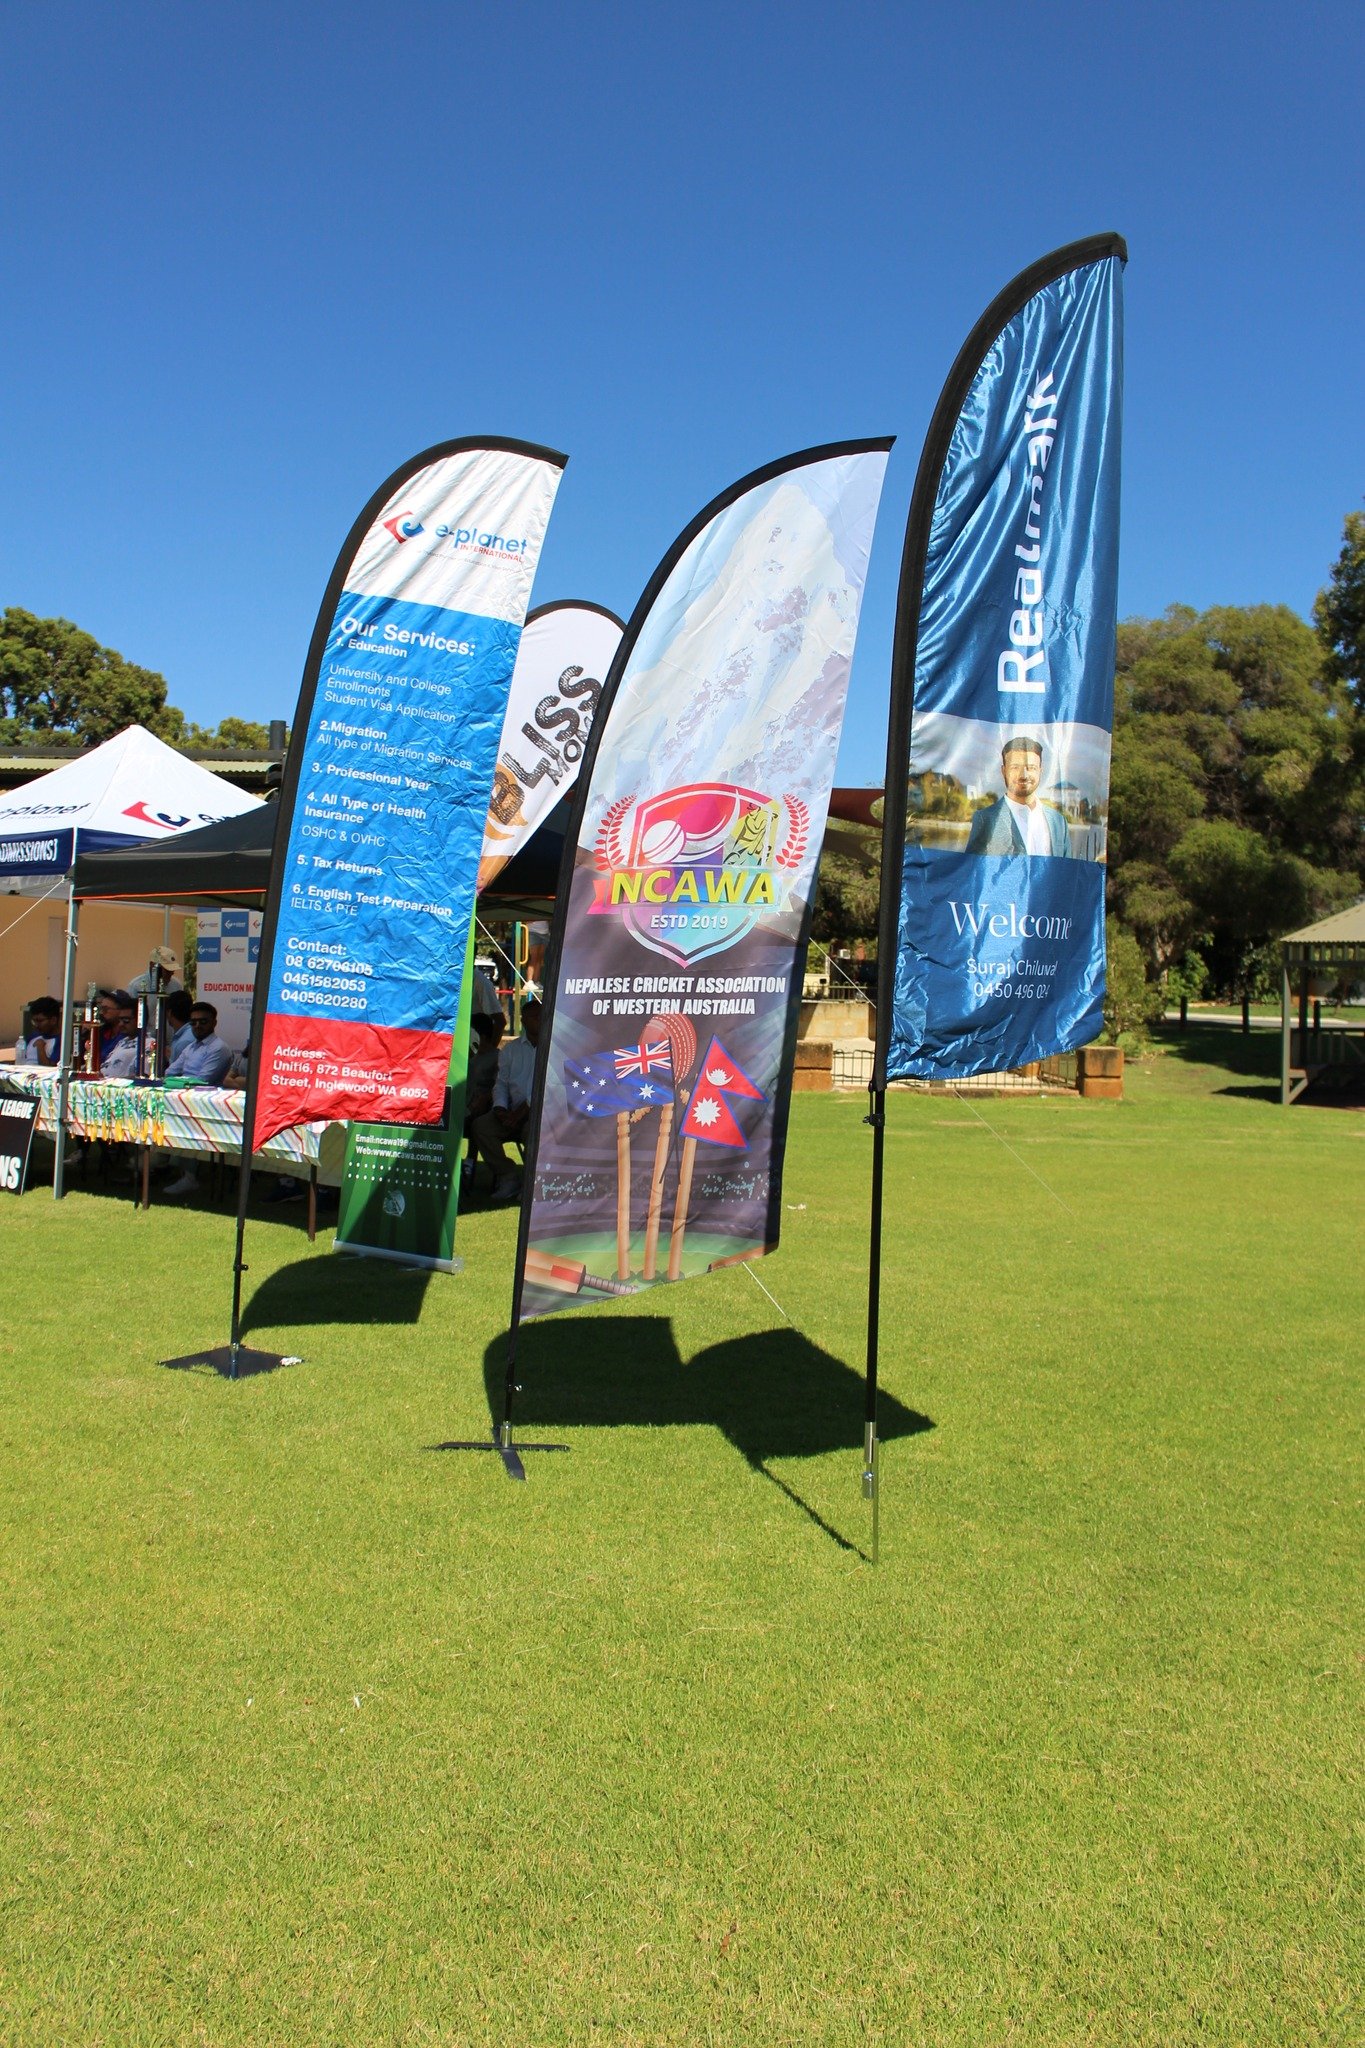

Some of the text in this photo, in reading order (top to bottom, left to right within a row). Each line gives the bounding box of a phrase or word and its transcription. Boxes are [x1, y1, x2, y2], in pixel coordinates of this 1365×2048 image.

[435, 523, 527, 554] e-planet
[460, 544, 524, 563] INTERNATIONAL
[336, 637, 408, 658] 1. Education
[340, 616, 476, 657] Our Services:
[327, 678, 391, 697] Enrollments
[329, 664, 451, 695] University and College
[324, 691, 456, 723] Student Visa Application
[316, 734, 473, 770] All type of Migration Services
[489, 665, 603, 826] BLISS
[312, 762, 432, 792] 3. Professional Year
[304, 805, 364, 825] Insurance
[306, 791, 427, 820] 4. All Type of Health
[301, 824, 386, 847] OSHC & OVHC
[296, 854, 383, 877] 5. Tax Returns
[610, 869, 775, 905] NCAWA
[290, 897, 358, 917] IELTS & PTE
[292, 883, 453, 917] 6. English Test Preparation
[650, 914, 729, 929] ESTD 2019
[947, 901, 1073, 940] Welcome
[287, 937, 348, 956] Contact:
[285, 954, 304, 968] 08
[966, 957, 1012, 979] Suraj
[203, 983, 244, 992] EDUCATION
[565, 976, 787, 995] NEPALESE CRICKET ASSOCIATION
[973, 982, 1013, 999] 0450
[1014, 984, 1035, 999] 496
[280, 989, 368, 1010] 0405620280
[592, 998, 756, 1016] OF WESTERN AUSTRALIA
[274, 1045, 327, 1061] Address:
[316, 1064, 339, 1076] 872
[271, 1074, 430, 1100] Street, Inglewood WA 6052
[1, 1098, 36, 1120] LEAGUE
